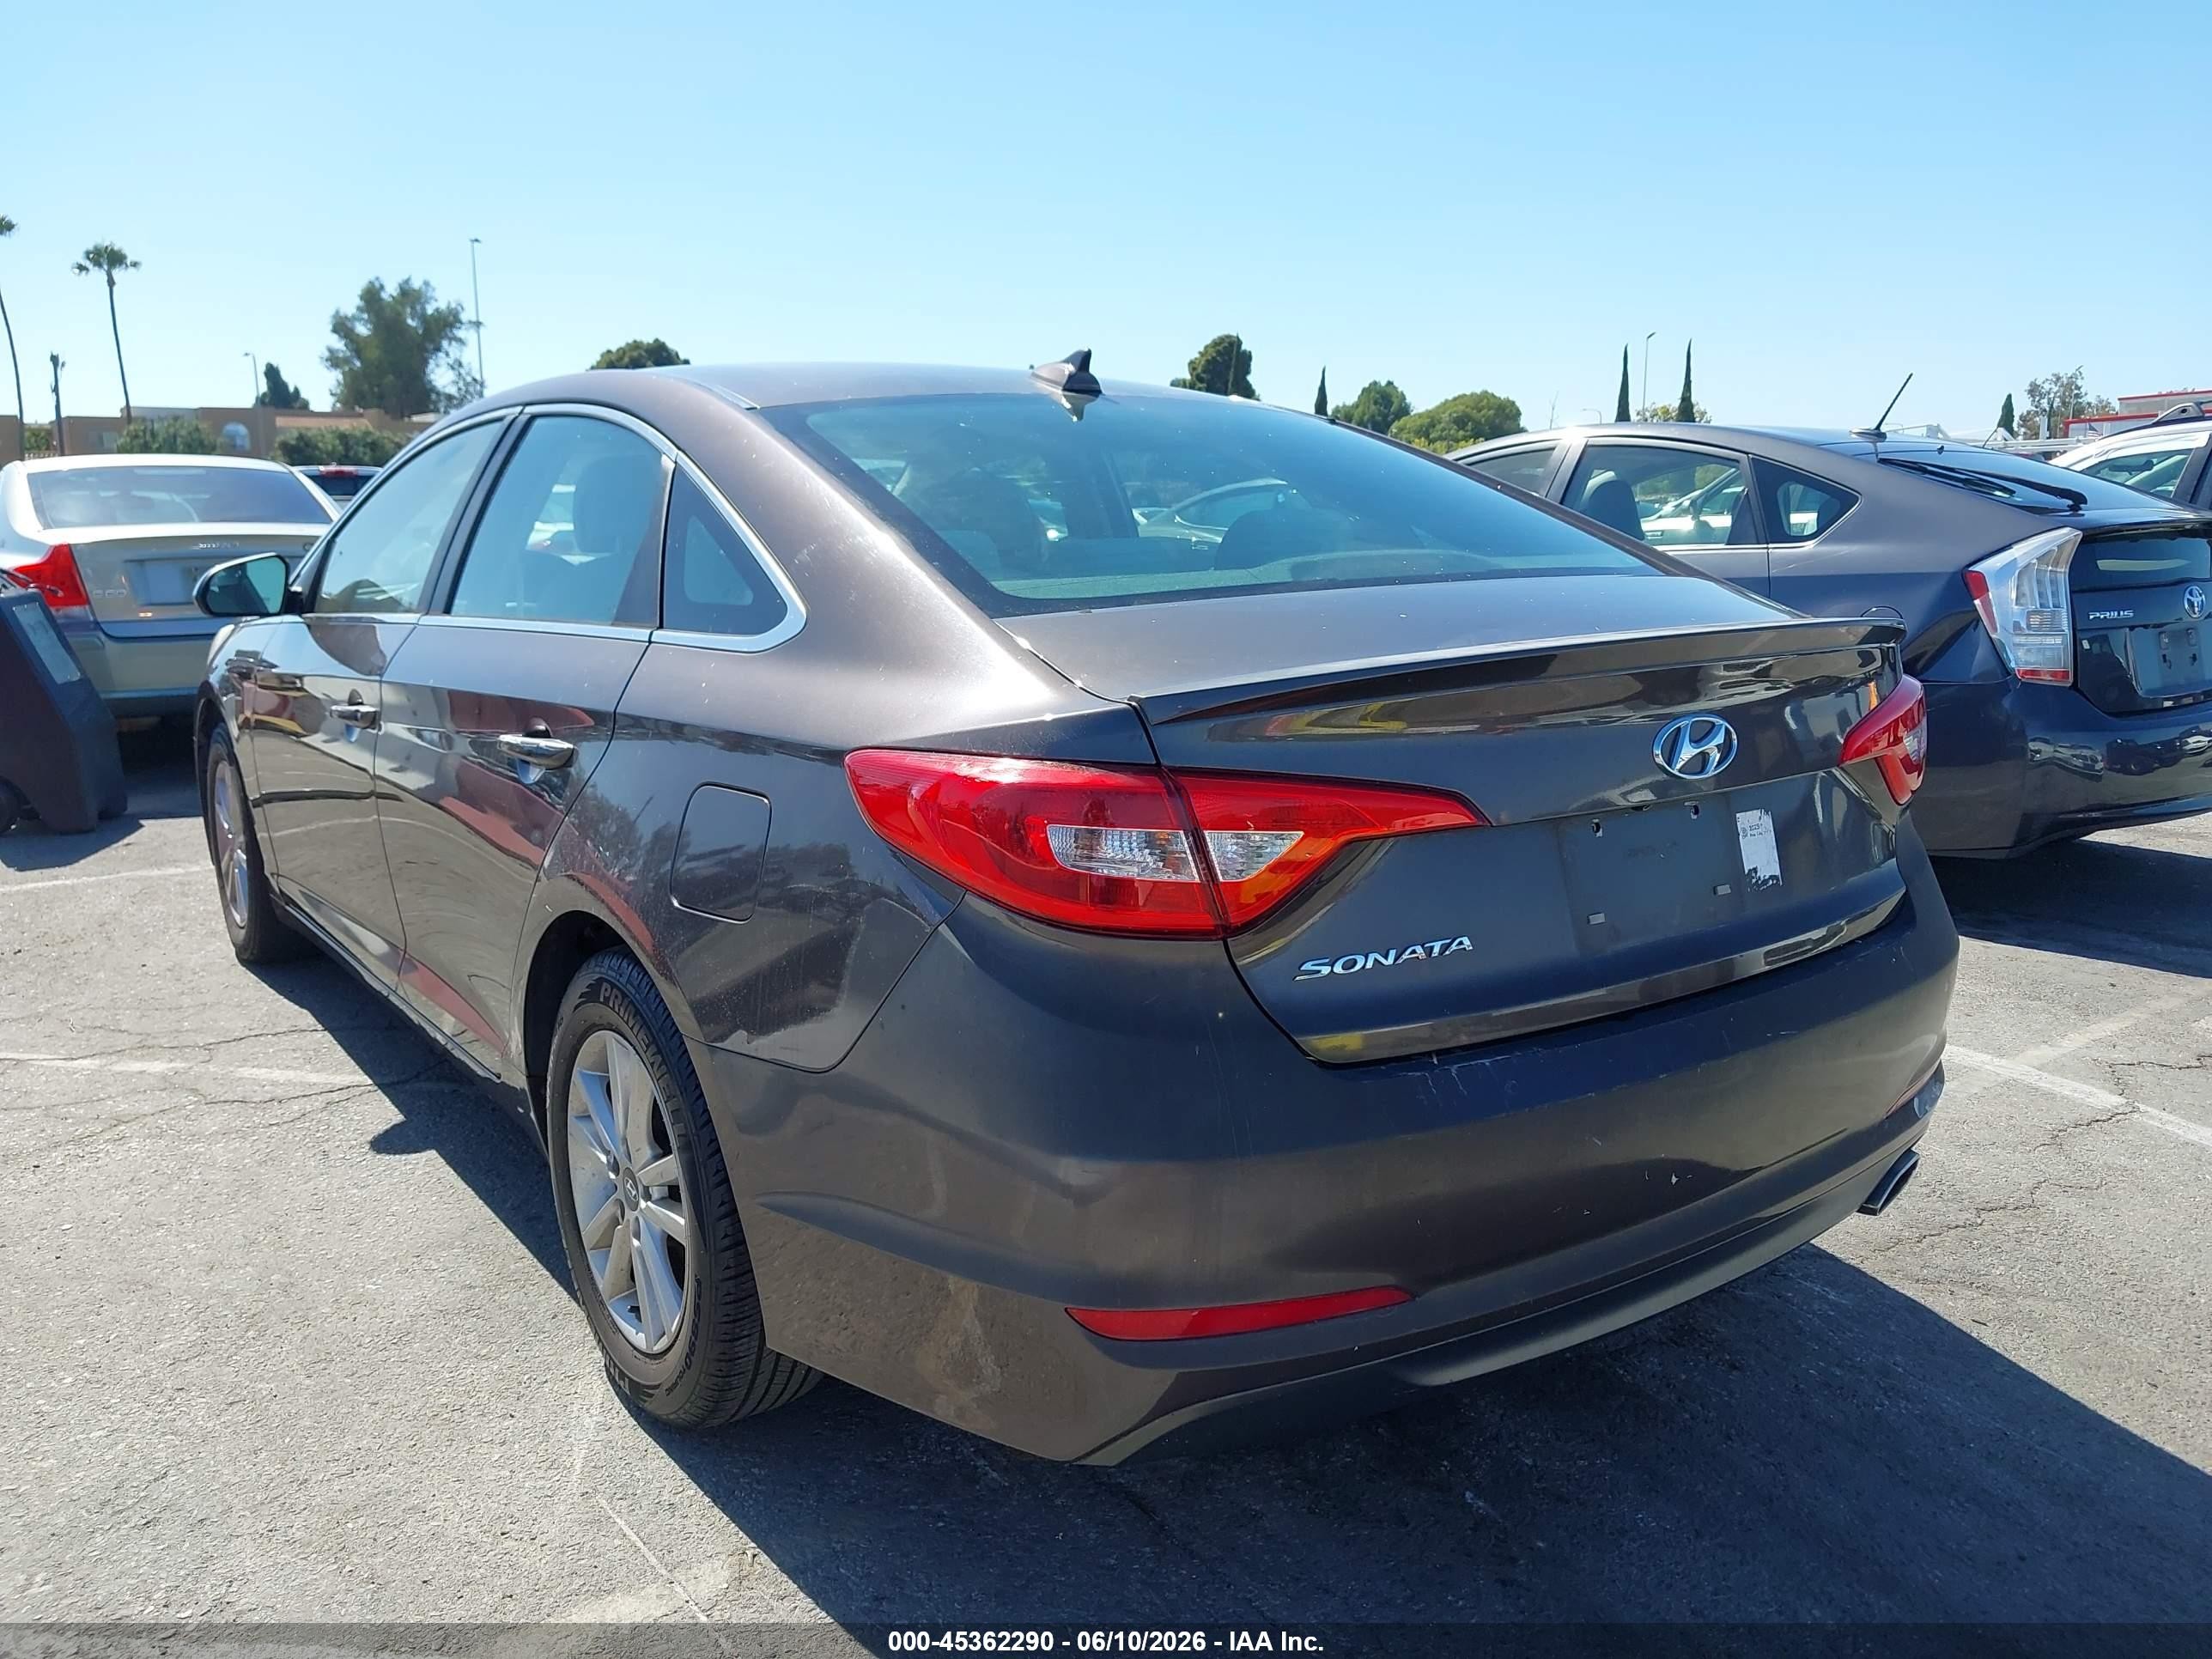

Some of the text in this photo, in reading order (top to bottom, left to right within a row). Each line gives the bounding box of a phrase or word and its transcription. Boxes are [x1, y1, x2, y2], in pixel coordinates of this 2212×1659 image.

[2088, 610, 2135, 620] PRIUS
[1292, 935, 1474, 981] SONATA
[600, 981, 686, 1149] PRIMEWELL
